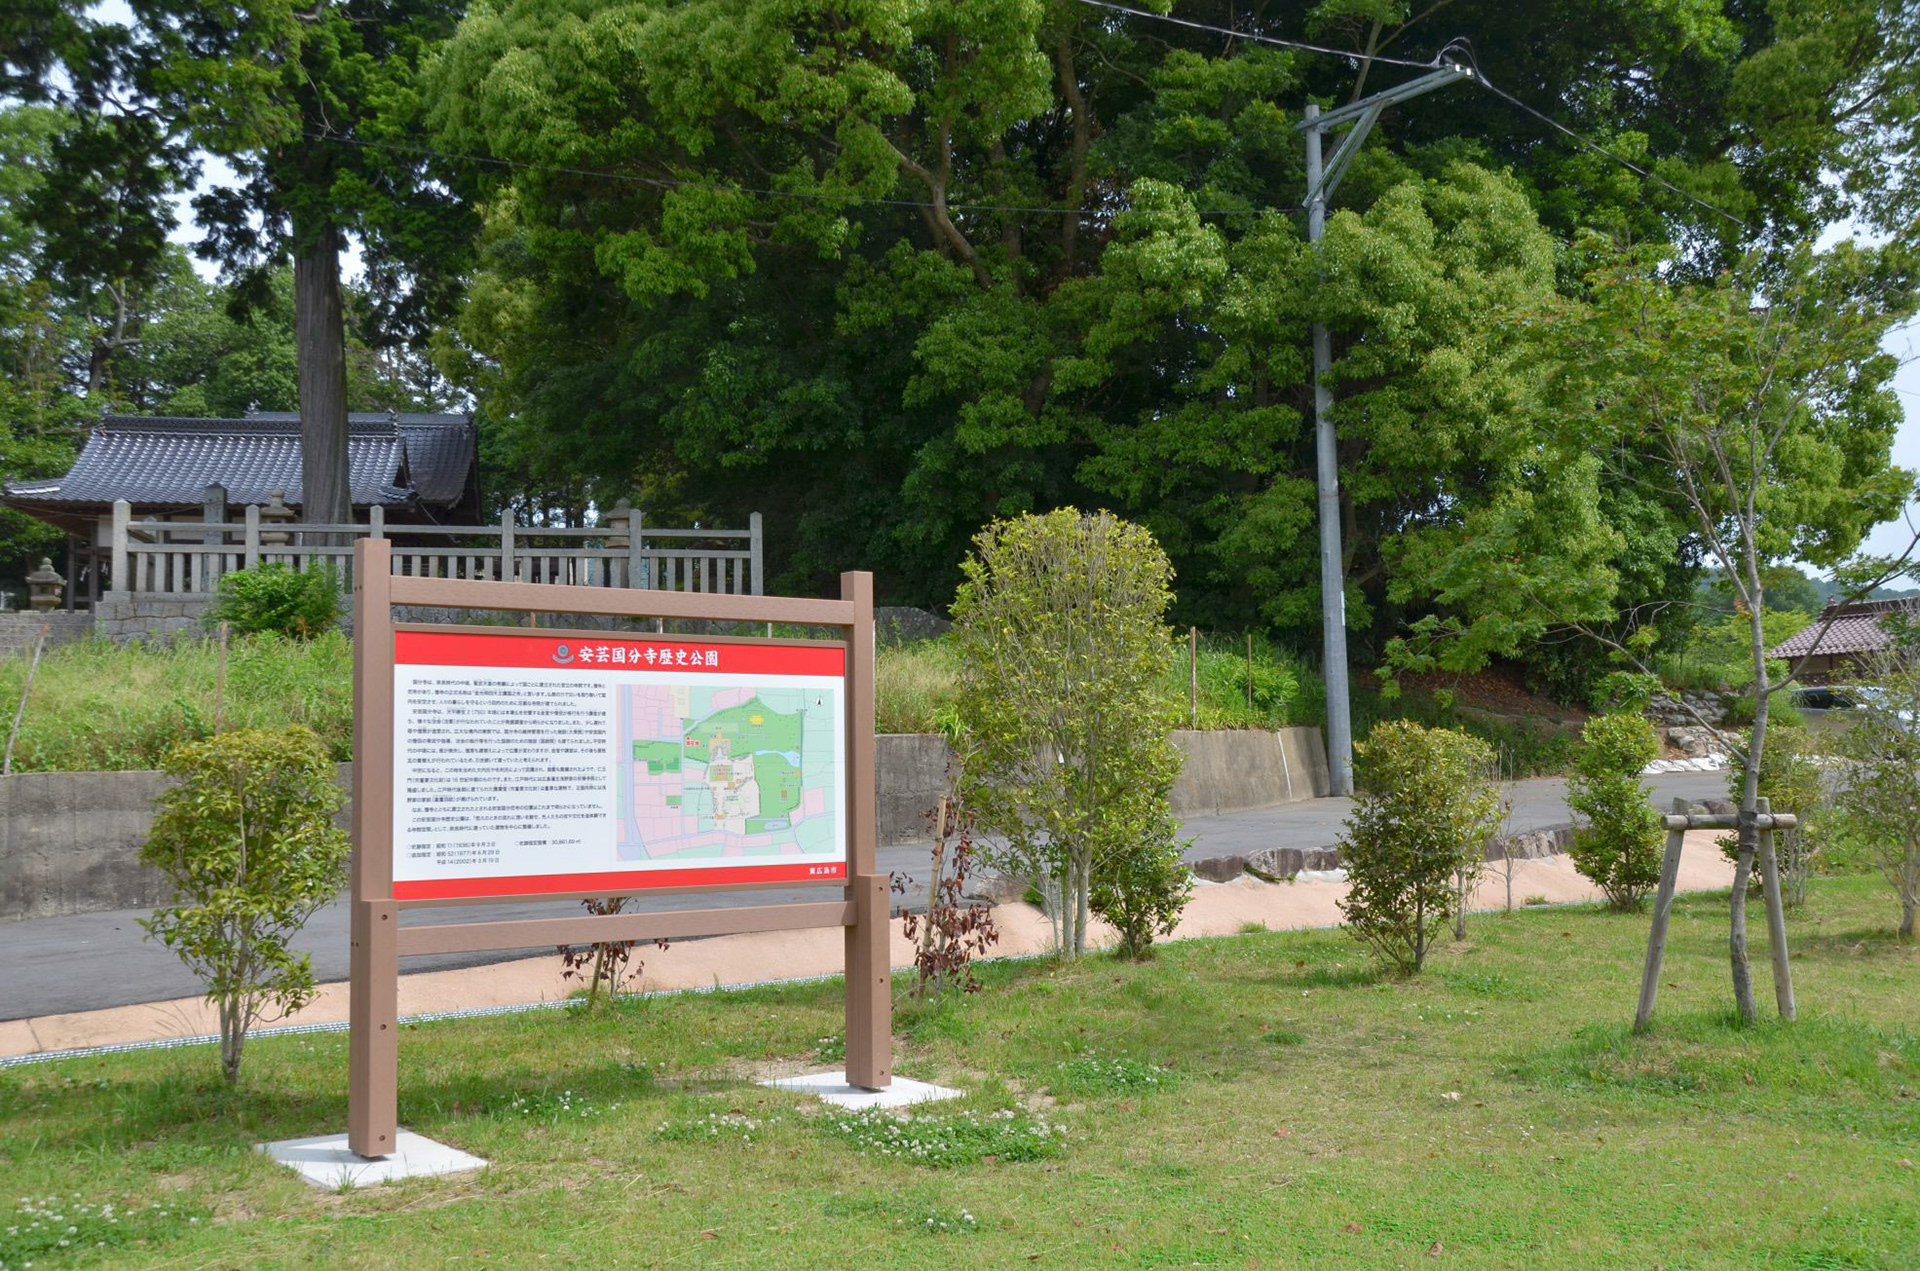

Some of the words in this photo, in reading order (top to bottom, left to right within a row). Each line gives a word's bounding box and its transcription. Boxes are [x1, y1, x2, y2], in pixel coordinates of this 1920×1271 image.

[578, 646, 719, 667] 安芸国分寺歴史公園
[809, 866, 837, 875] 東広島市
